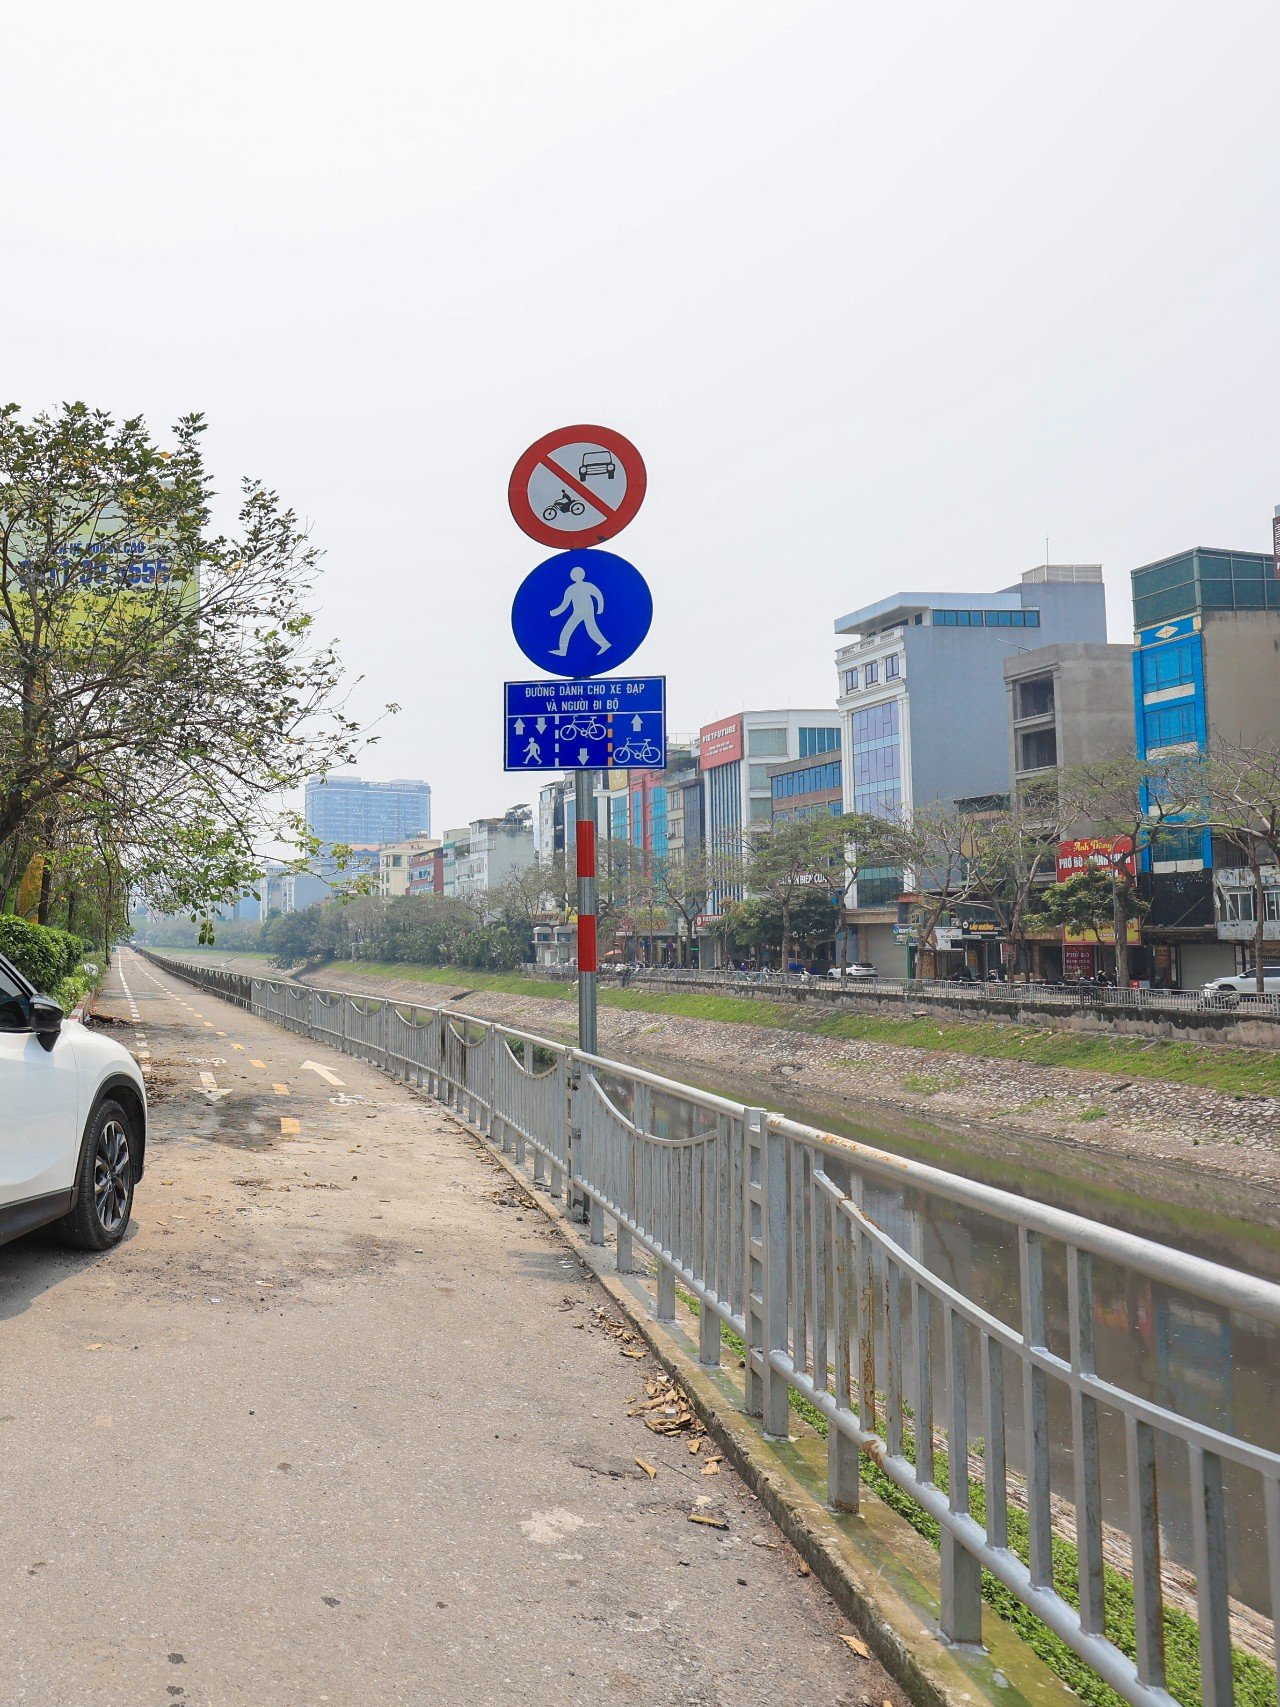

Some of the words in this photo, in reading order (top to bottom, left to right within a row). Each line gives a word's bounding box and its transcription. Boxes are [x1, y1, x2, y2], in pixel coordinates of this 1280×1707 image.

[525, 684, 555, 697] ĐƯỜNG
[559, 683, 583, 696] DÀNH
[587, 685, 605, 695] CHO
[610, 684, 621, 694] XE
[626, 683, 645, 695] ĐẠP
[546, 699, 557, 712] VÀ
[561, 699, 588, 711] NGƯỜI
[593, 700, 602, 710] ĐI
[607, 697, 619, 711] BỘ
